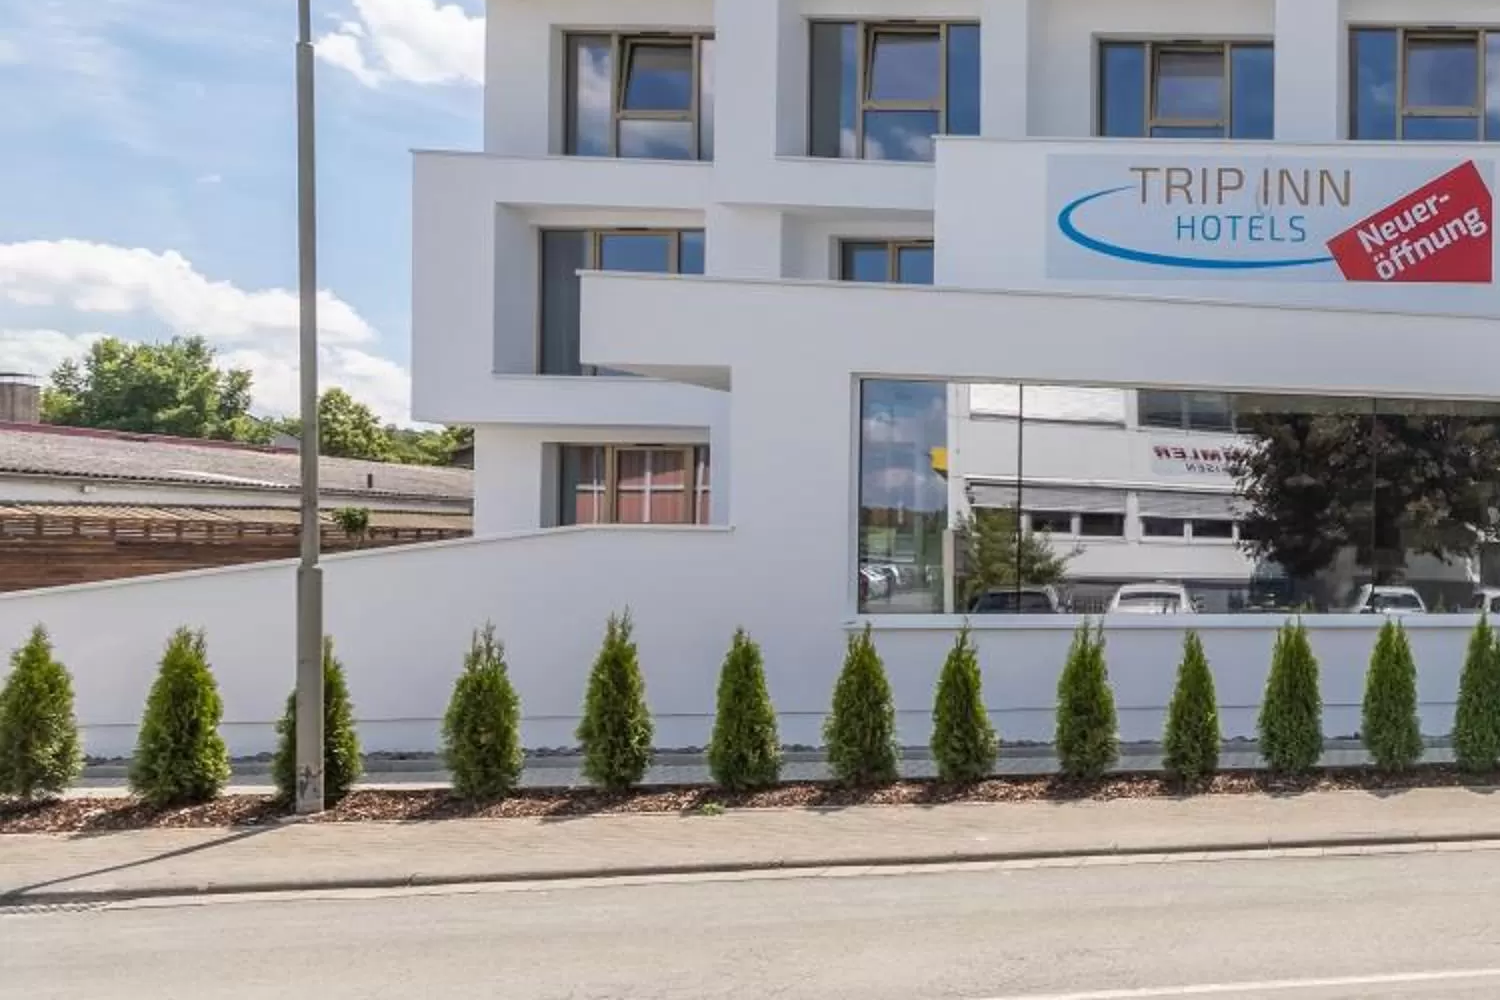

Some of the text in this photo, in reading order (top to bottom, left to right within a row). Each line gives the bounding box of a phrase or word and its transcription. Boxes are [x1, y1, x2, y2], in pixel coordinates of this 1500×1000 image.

[1129, 167, 1351, 207] TRIP INN
[1176, 215, 1306, 242] HOTELS
[1356, 194, 1450, 253] Neuer-
[1373, 207, 1489, 280] öffnung
